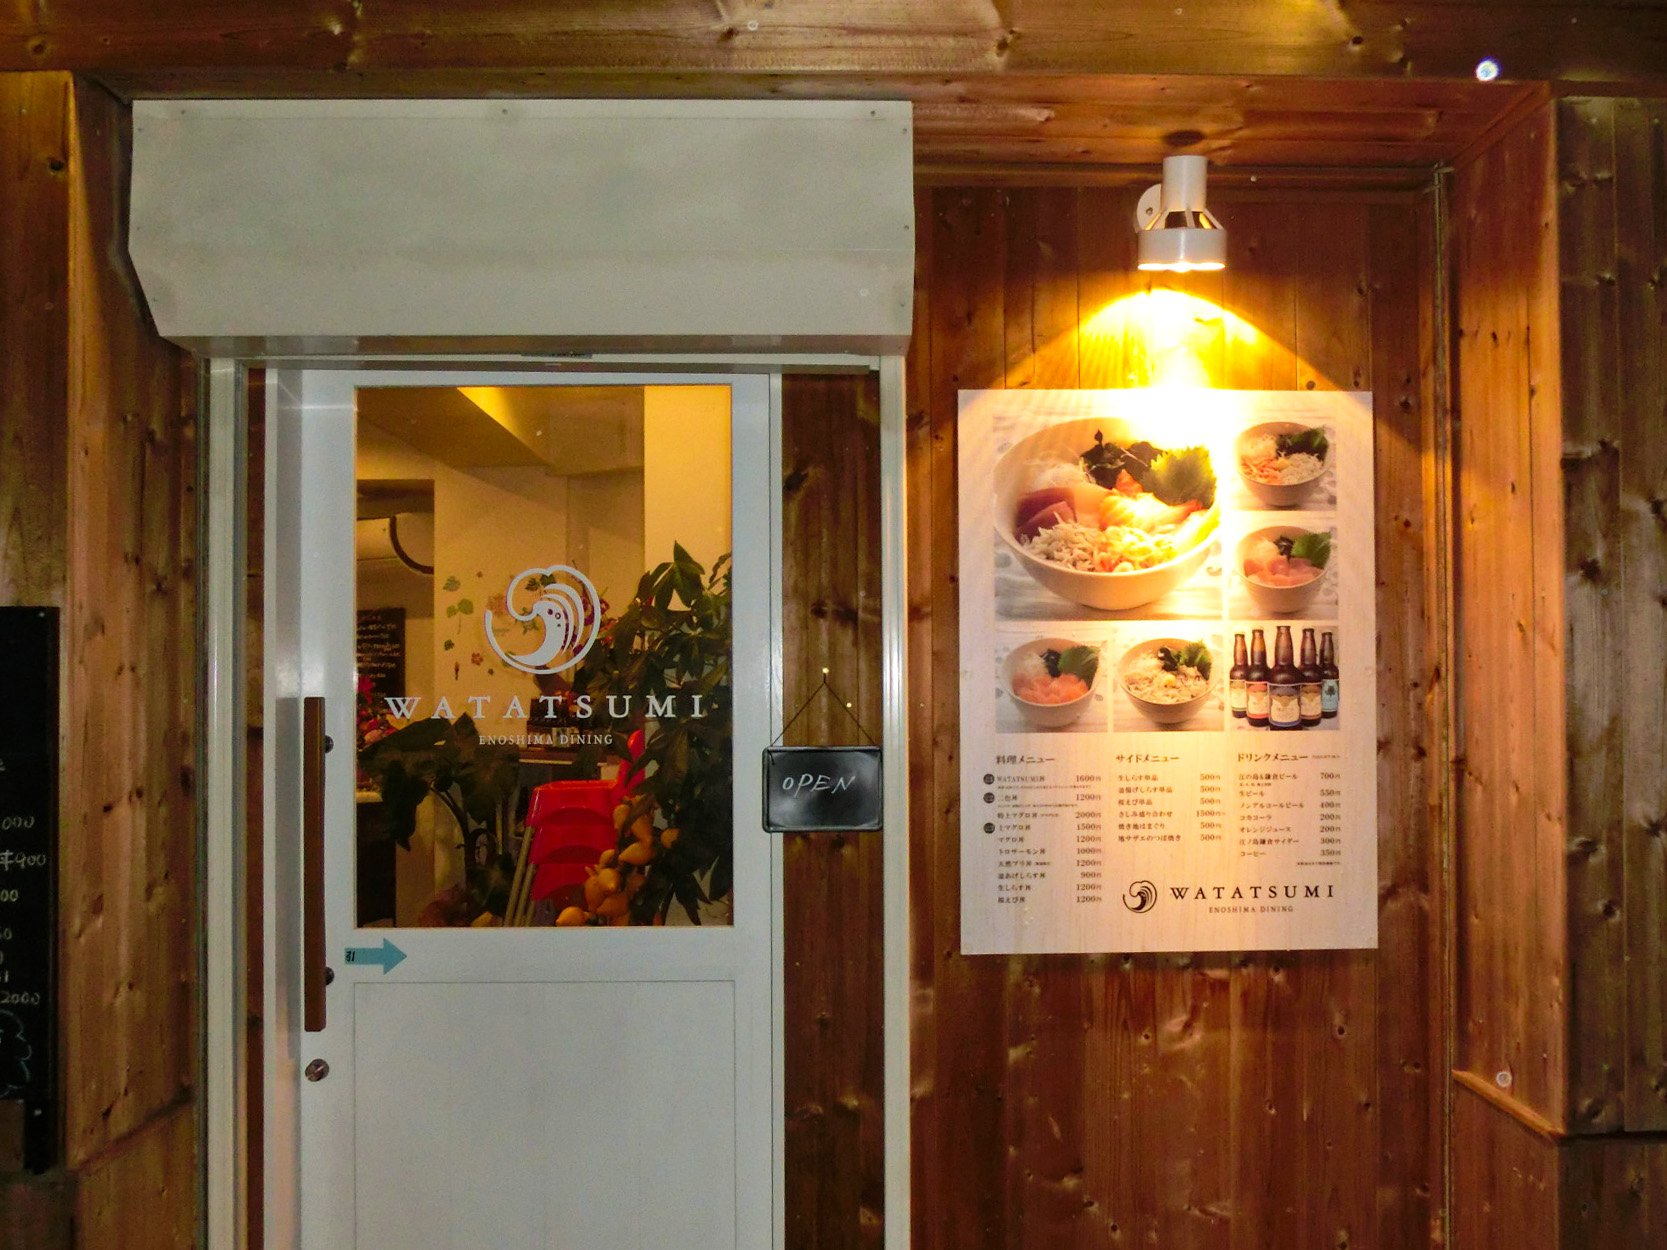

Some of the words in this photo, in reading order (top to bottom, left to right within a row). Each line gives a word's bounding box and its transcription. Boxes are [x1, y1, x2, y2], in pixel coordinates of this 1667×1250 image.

[384, 694, 704, 719] WATATSUMI
[479, 734, 553, 746] ENOSHIMA
[560, 734, 613, 744] DINING
[996, 755, 1055, 764] 料理メニュー
[1116, 754, 1180, 763] サイドメニュー
[1237, 753, 1308, 762] ドリンクメニュー
[782, 773, 855, 798] OPEN
[1170, 885, 1334, 900] WATATSUMI
[1209, 906, 1256, 914] ENOSHIMA
[1260, 905, 1294, 913] DINING
